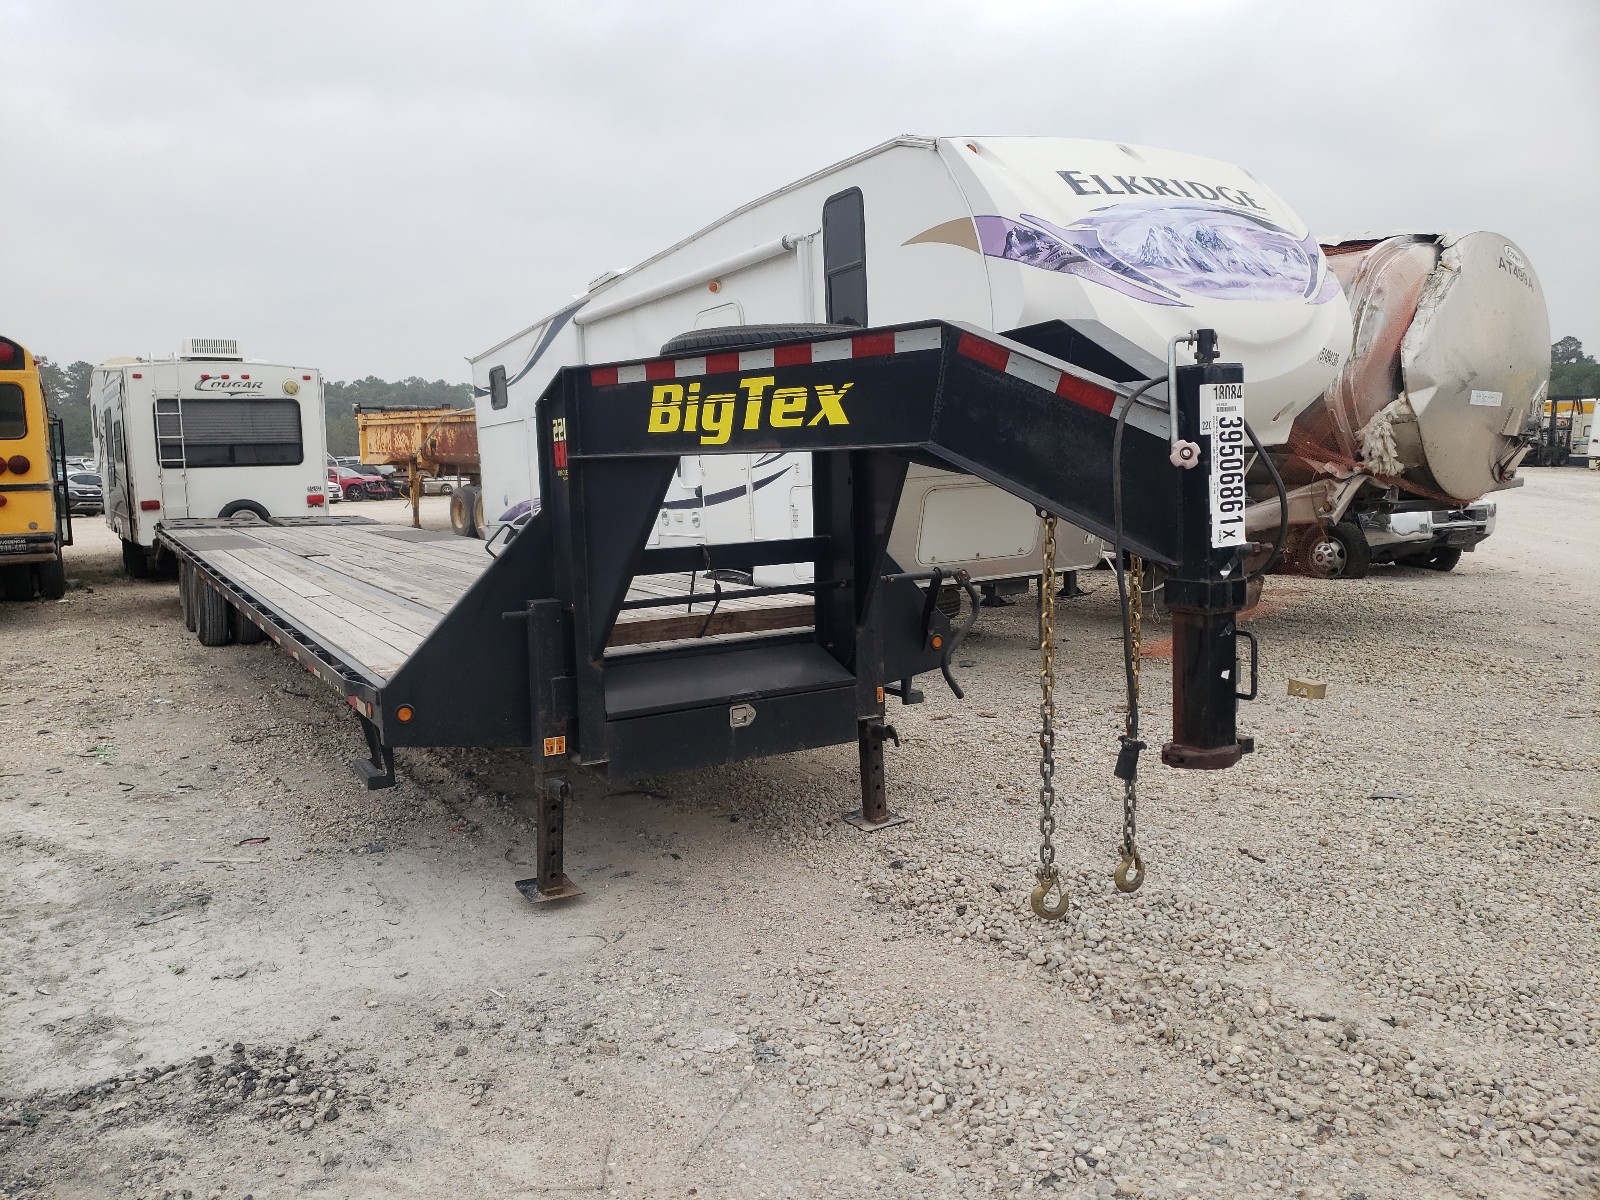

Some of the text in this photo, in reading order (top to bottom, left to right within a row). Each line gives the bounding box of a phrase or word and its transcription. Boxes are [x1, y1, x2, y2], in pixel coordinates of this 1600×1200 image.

[1055, 170, 1267, 211] ELKRIDGE
[194, 376, 264, 391] COUGAR
[648, 375, 855, 445] BigTex
[1219, 416, 1244, 525] 39506861
